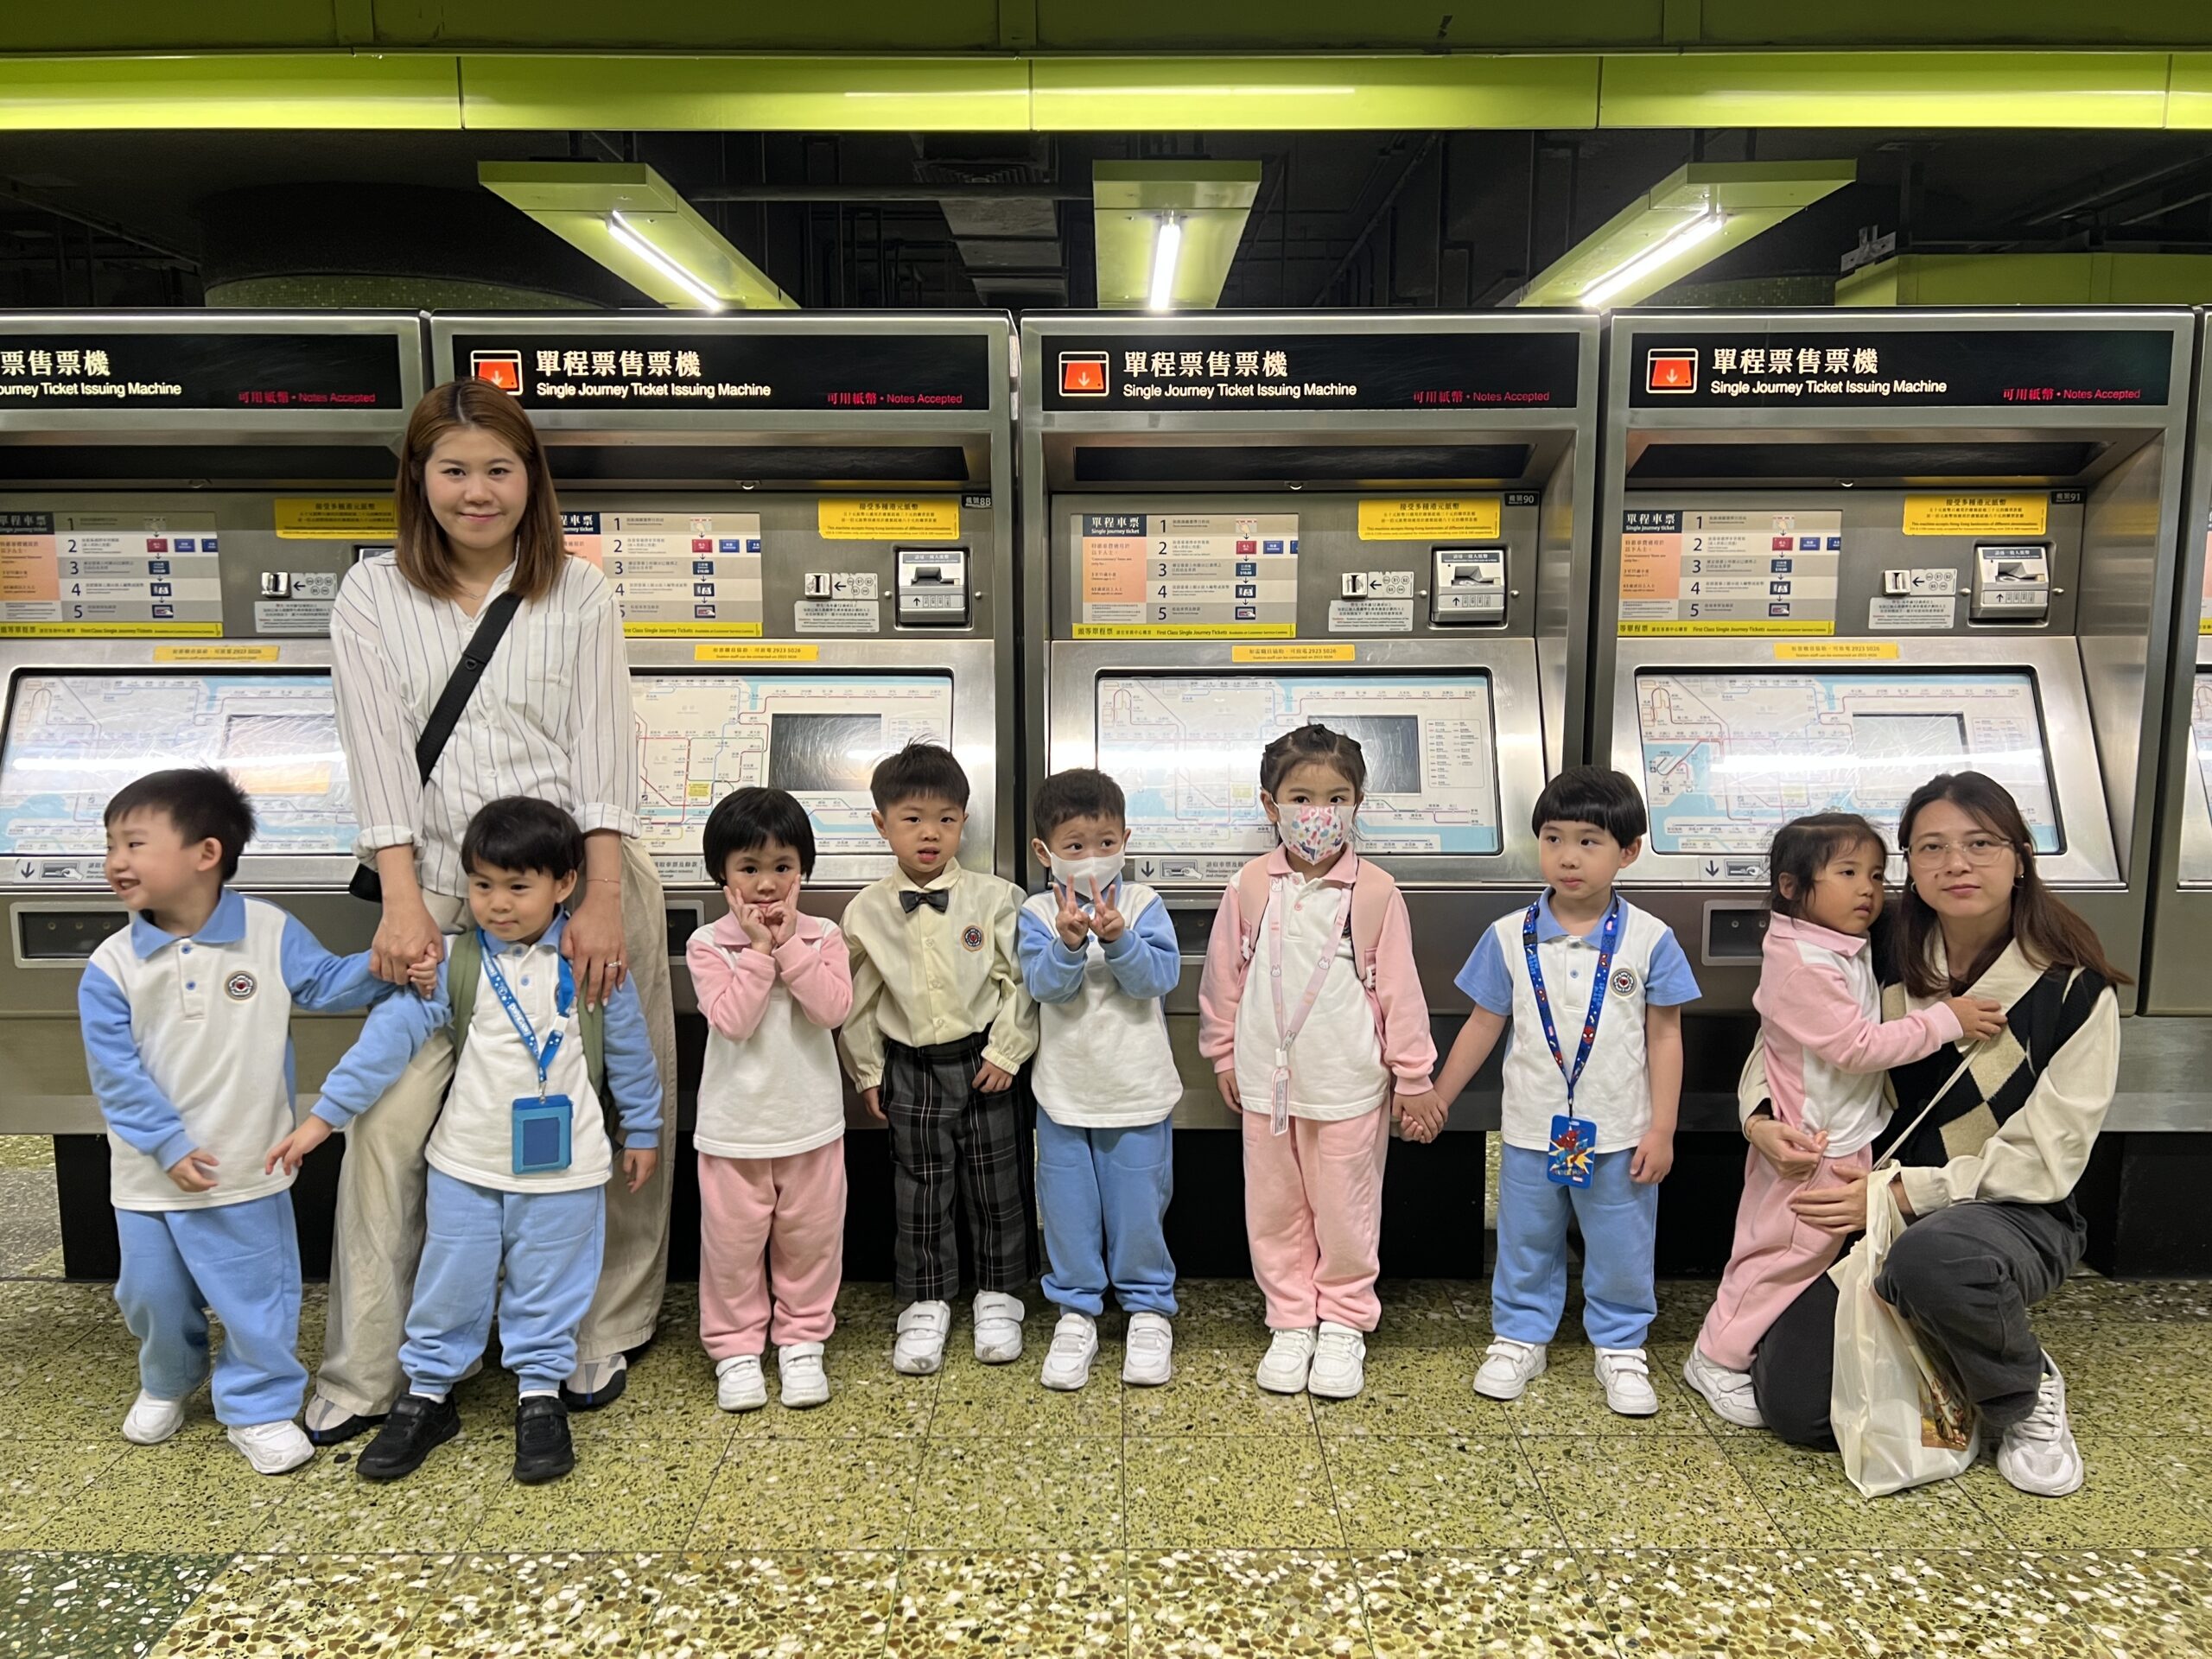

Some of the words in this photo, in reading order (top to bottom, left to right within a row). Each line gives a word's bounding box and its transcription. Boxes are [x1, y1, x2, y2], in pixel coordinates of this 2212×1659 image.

[0, 349, 111, 377] 票售票機
[536, 350, 702, 378] 單程票售票機
[1123, 350, 1288, 378] 單程票售票機
[1712, 347, 1878, 375] 單程票售票機
[40, 382, 79, 396] Ticket
[80, 382, 126, 398] Issuing
[128, 382, 182, 395] Machine
[536, 382, 576, 399] Single
[578, 382, 629, 399] Journey
[630, 382, 669, 397] Ticket
[671, 382, 715, 399] Issuing
[717, 382, 772, 397] Machine
[1122, 383, 1162, 399] Single
[1165, 383, 1215, 399] Journey
[1216, 383, 1255, 397] Ticket
[1256, 383, 1301, 399] Issuing
[1303, 383, 1357, 397] Machine
[1710, 379, 1751, 397] Single
[1752, 379, 1804, 397] Journey
[1805, 379, 1844, 394] Ticket
[1846, 379, 1891, 397] Issuing
[1892, 379, 1948, 394] Machine
[299, 393, 327, 403] Notes
[330, 393, 375, 404] Accepted
[887, 394, 915, 404] Notes
[918, 394, 963, 405] Accepted
[1473, 392, 1502, 401] Notes
[1504, 391, 1549, 402] Accepted
[2063, 390, 2093, 399] Notes
[2094, 390, 2140, 401] Accepted
[67, 518, 73, 531] 1
[613, 518, 620, 531] 1
[1160, 519, 1166, 532] 1
[1696, 516, 1702, 529] 1
[68, 540, 77, 553] 2
[613, 539, 622, 552] 2
[1159, 542, 1166, 555] 2
[1693, 538, 1702, 551] 2
[70, 562, 79, 575] 3
[614, 562, 623, 575] 3
[1159, 563, 1166, 576] 3
[1692, 560, 1701, 573] 3
[72, 583, 80, 596] 4
[615, 583, 625, 595] 4
[1158, 586, 1166, 598] 4
[1691, 582, 1700, 594] 4
[74, 606, 82, 618] 5
[1159, 607, 1166, 620] 5
[1690, 604, 1699, 616] 5
